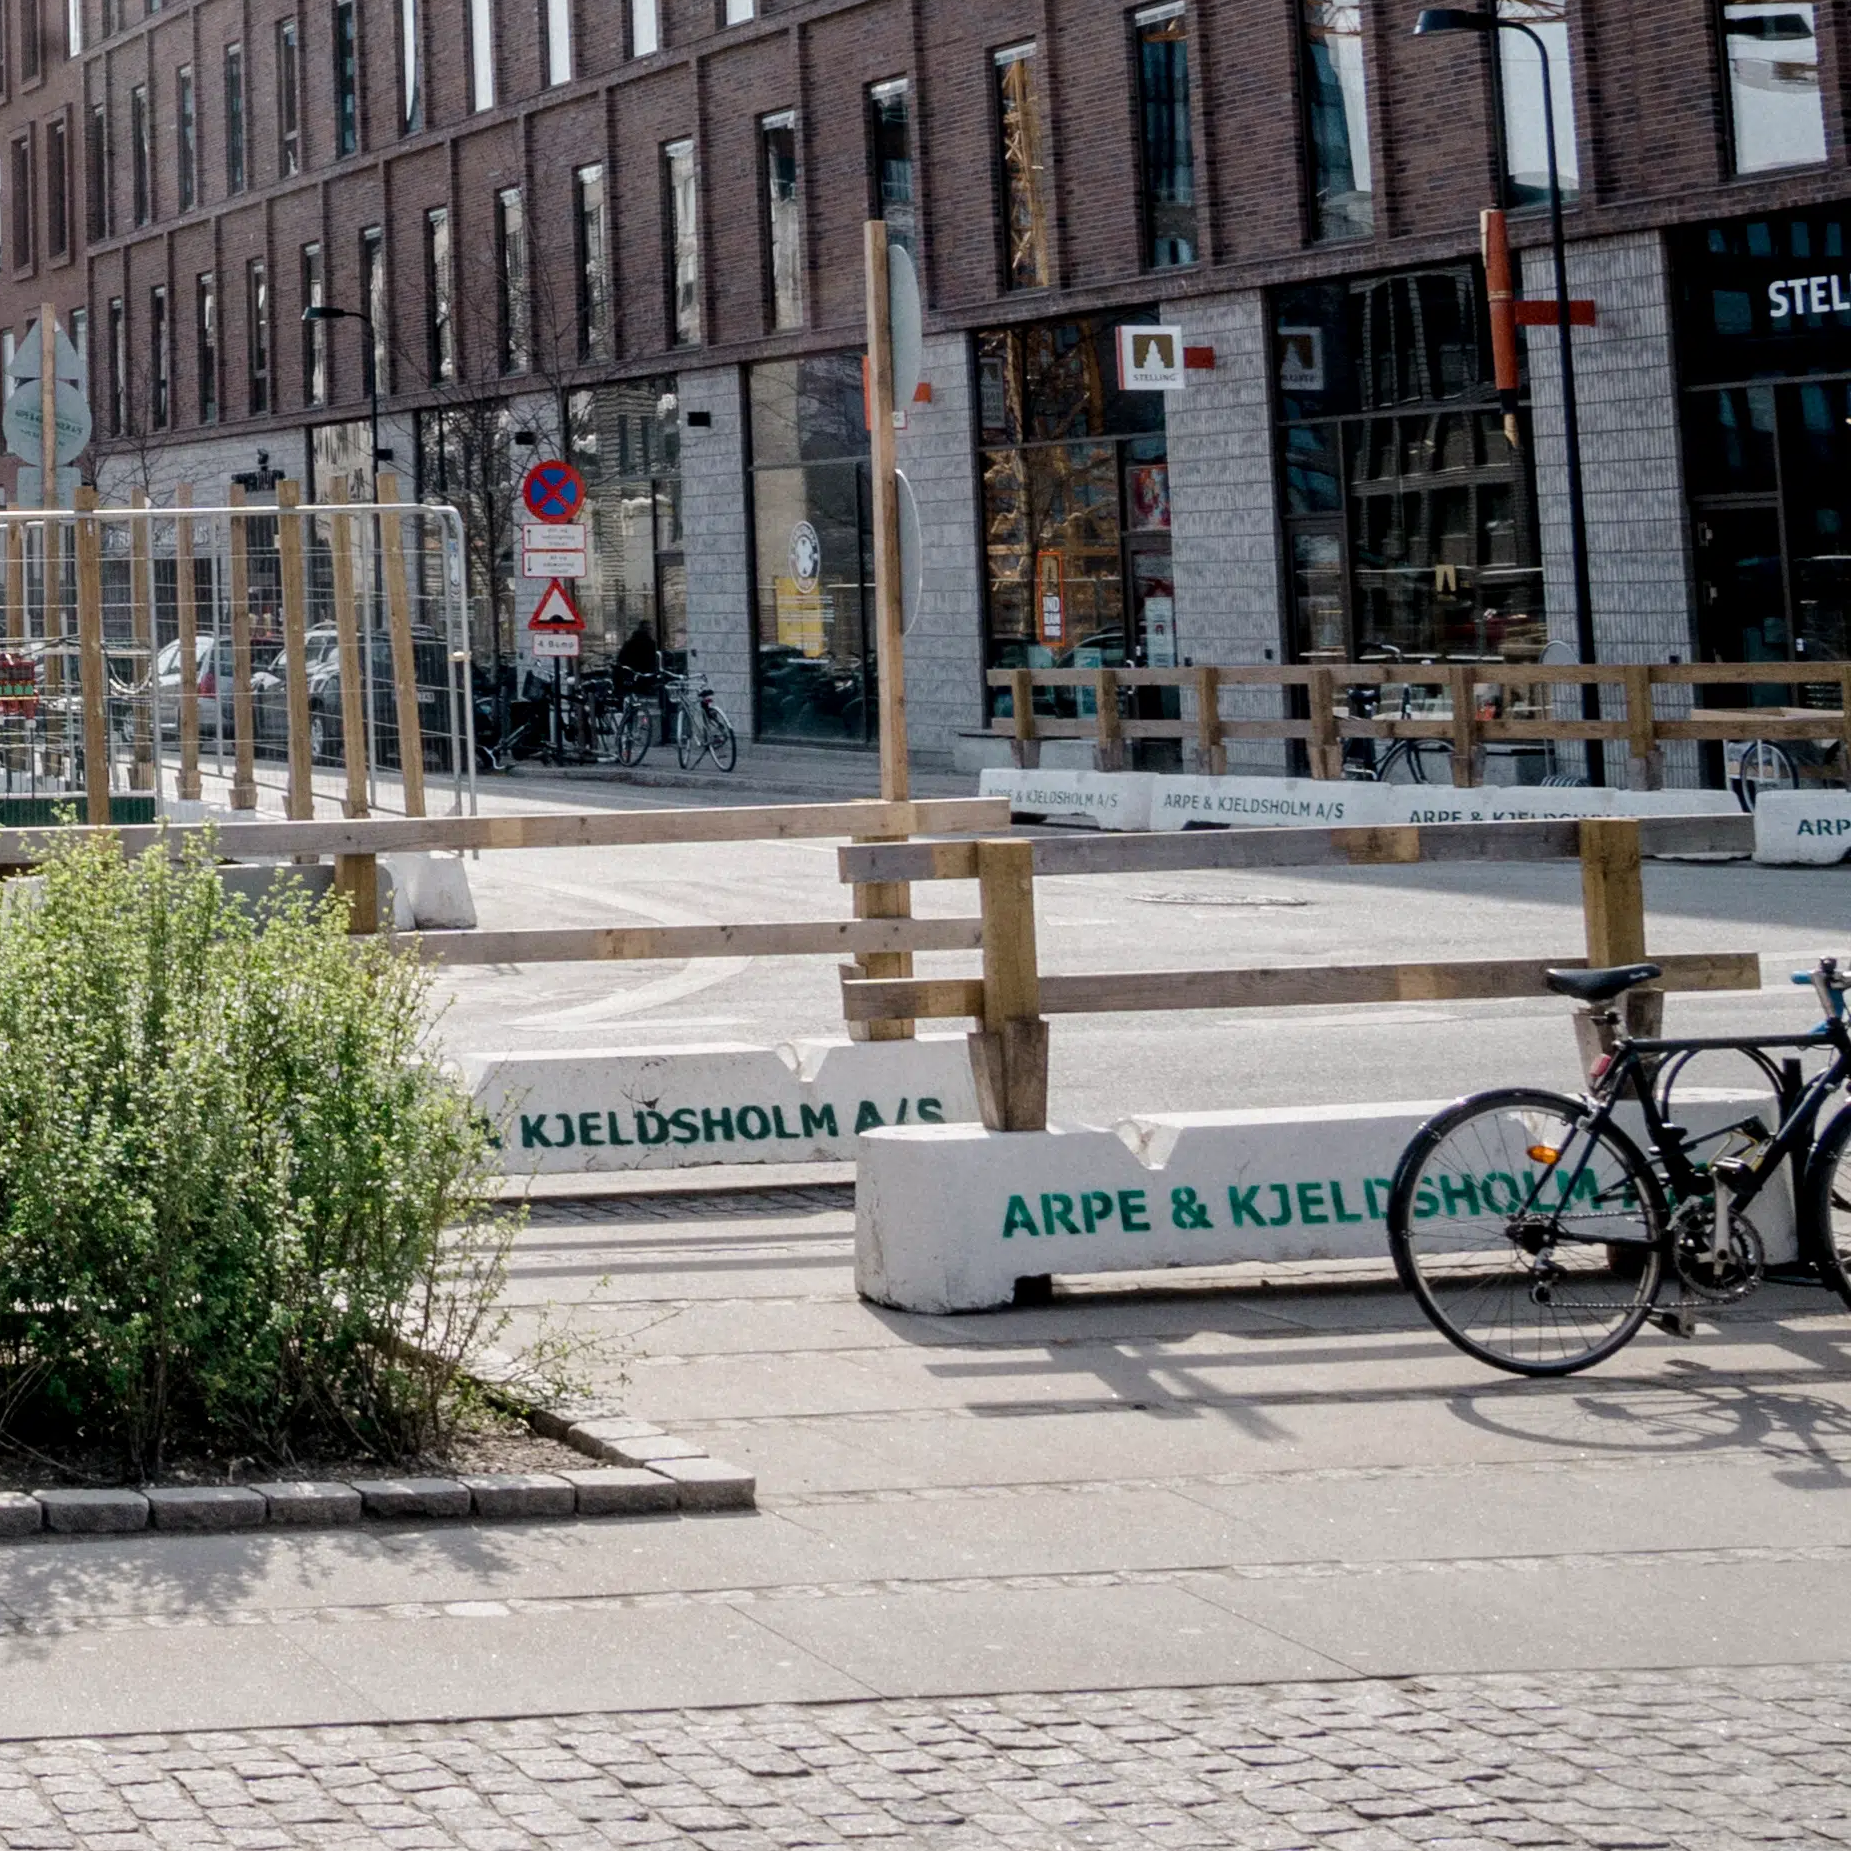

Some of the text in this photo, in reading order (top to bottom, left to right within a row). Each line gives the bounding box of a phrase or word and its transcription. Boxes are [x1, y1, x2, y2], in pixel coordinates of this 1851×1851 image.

[1133, 373, 1176, 382] STELLING
[1026, 789, 1094, 806] KJELDSHOLM
[1098, 793, 1118, 808] A/S
[1163, 793, 1345, 821] ARPE & KJELDSHOLM A/S
[520, 1101, 840, 1148] KJELDSHOLM
[1002, 1188, 1152, 1239] ARPE
[1170, 1184, 1215, 1230] &
